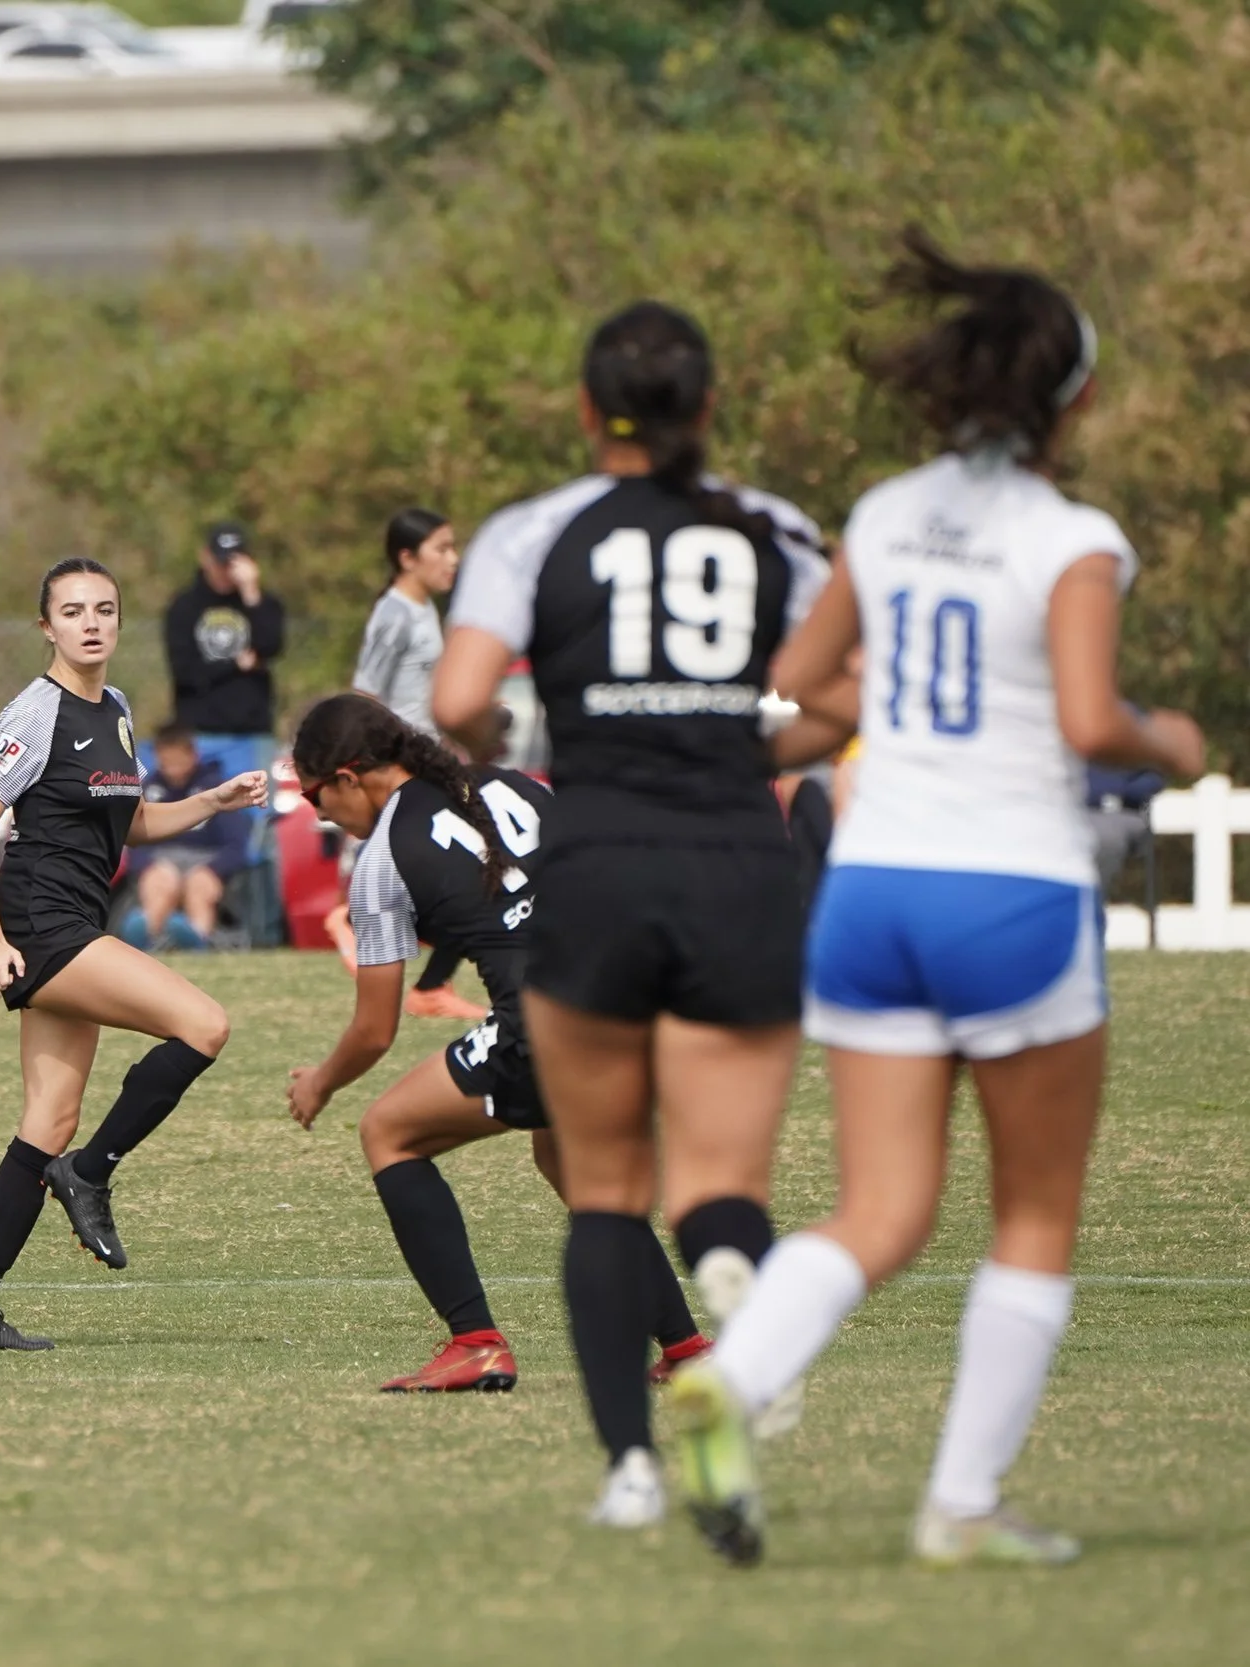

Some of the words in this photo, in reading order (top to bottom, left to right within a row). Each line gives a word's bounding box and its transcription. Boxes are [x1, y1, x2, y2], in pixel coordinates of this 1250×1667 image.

[590, 524, 758, 680] 19
[888, 588, 979, 734] 10
[431, 778, 541, 893] 14
